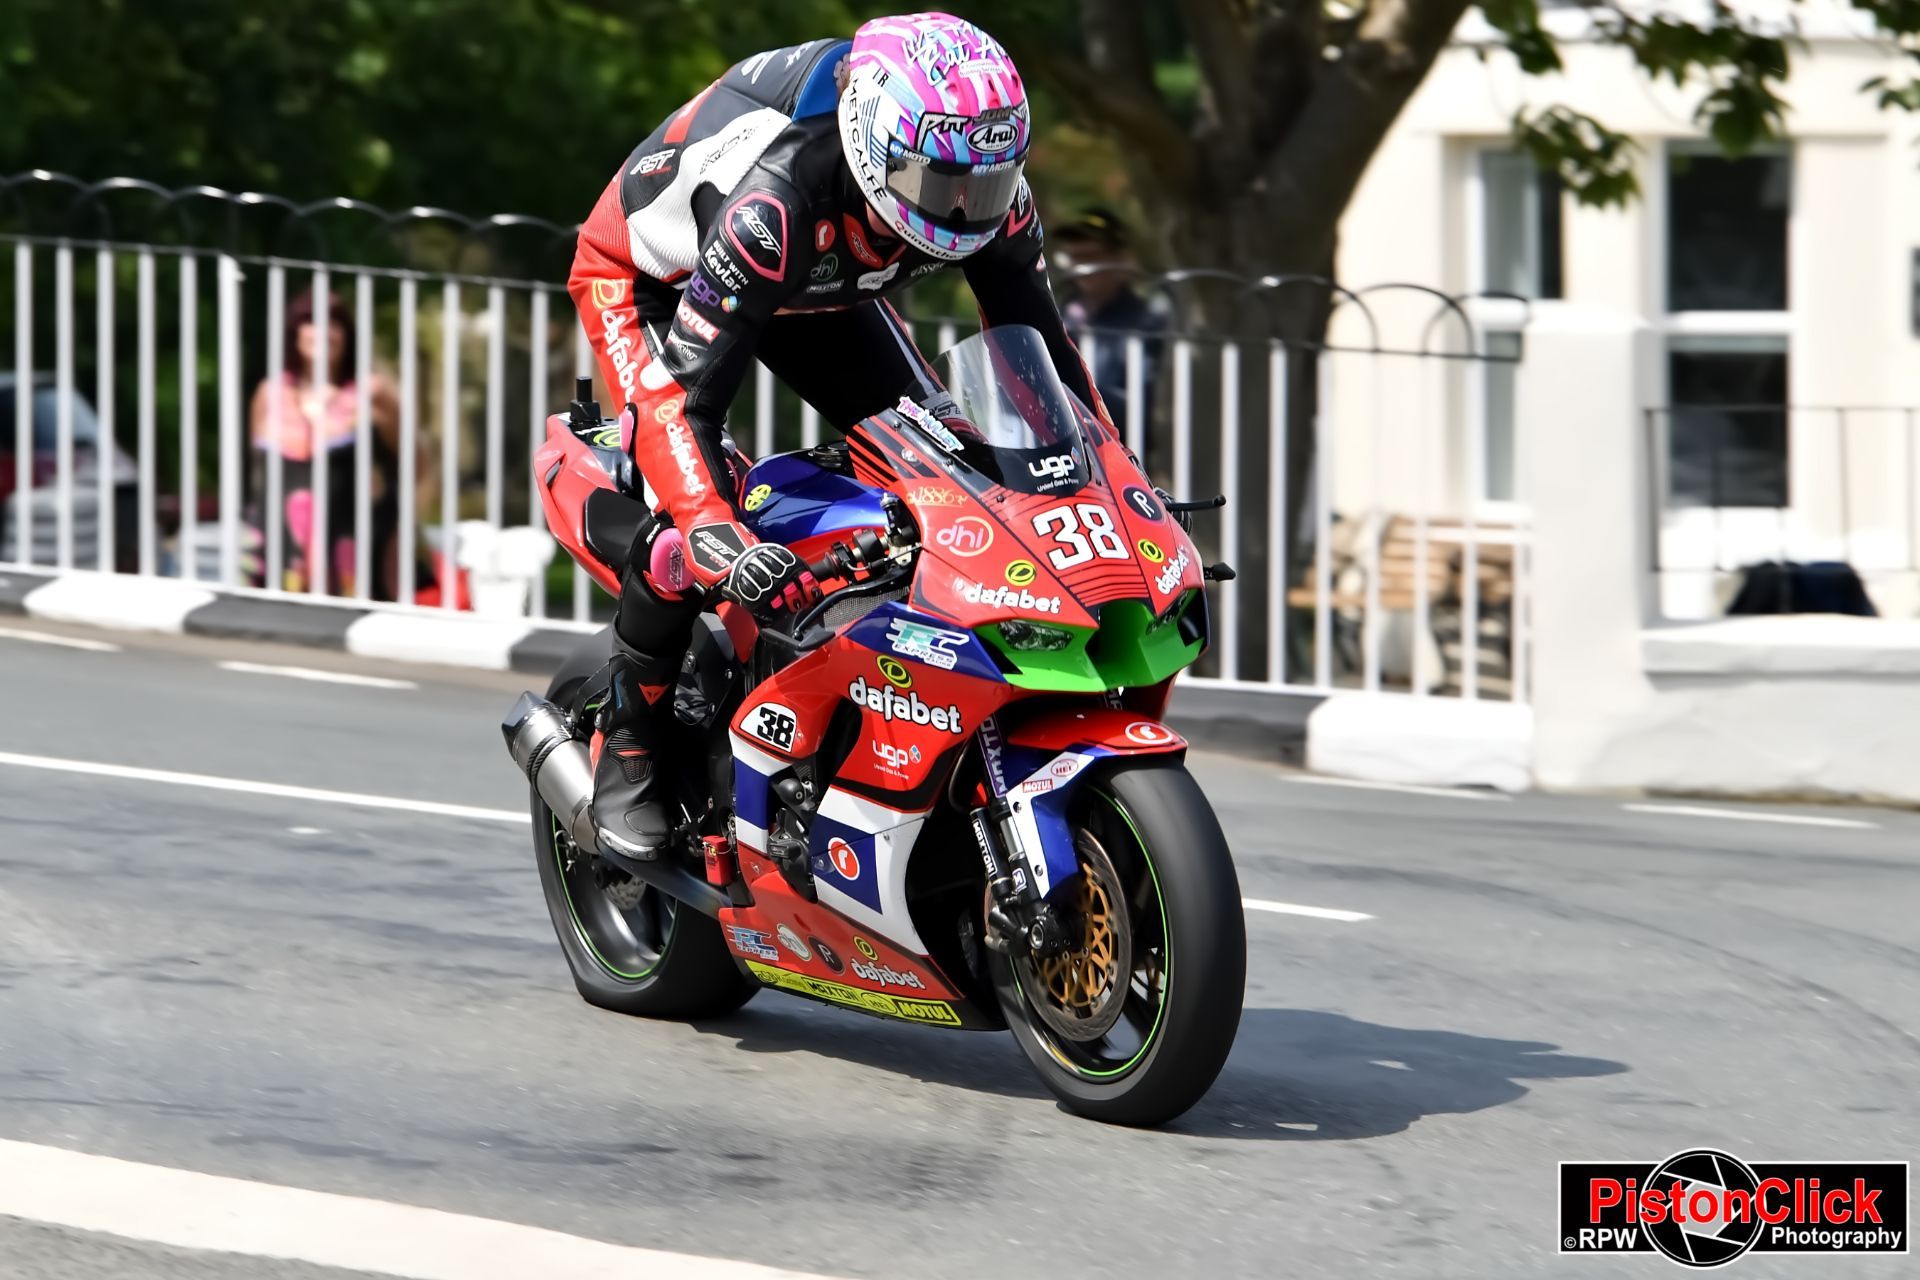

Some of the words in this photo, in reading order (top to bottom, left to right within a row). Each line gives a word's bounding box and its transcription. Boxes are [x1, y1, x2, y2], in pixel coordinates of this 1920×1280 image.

[849, 78, 888, 202] METCALFE
[972, 126, 1013, 145] Arai
[903, 150, 931, 164] MOTO
[735, 206, 782, 257] RST
[712, 239, 731, 266] BUILT
[729, 263, 749, 286] WITH
[676, 302, 718, 340] OTUL
[602, 309, 639, 403] dafab
[666, 422, 706, 496] dafabet
[1028, 455, 1075, 478] ugp
[695, 531, 739, 557] RST
[936, 525, 984, 549] dhl
[1032, 503, 1130, 571] 38
[964, 584, 1062, 614] dafabet
[849, 677, 963, 733] dafabet
[756, 707, 796, 749] 38
[872, 740, 909, 769] ugp
[1023, 779, 1052, 793] MOTUL
[851, 958, 926, 989] dafabet
[899, 1001, 952, 1021] MOTUL
